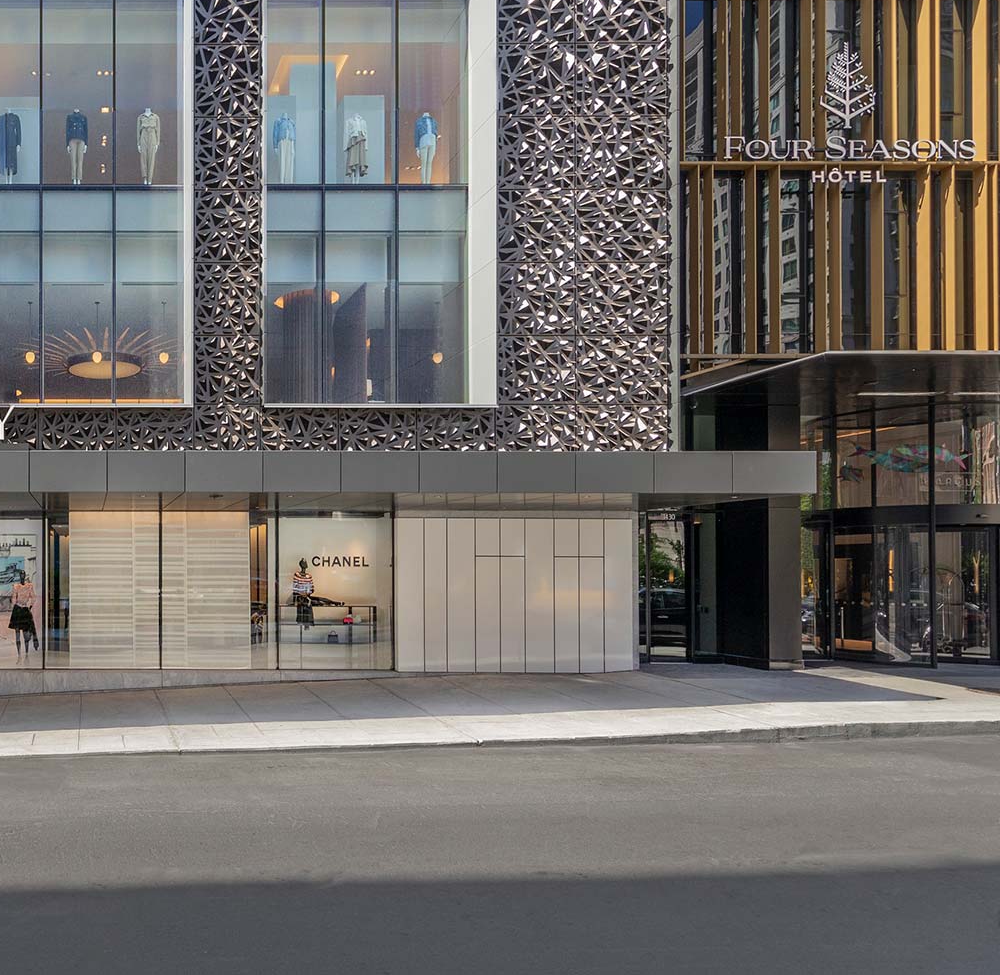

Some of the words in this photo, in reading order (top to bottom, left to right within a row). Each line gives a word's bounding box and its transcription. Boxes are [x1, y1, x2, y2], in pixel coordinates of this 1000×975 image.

[723, 136, 814, 160] FOUR
[825, 135, 977, 160] SEASONS
[811, 167, 887, 183] HÔTEL
[311, 556, 369, 567] CHANEL
